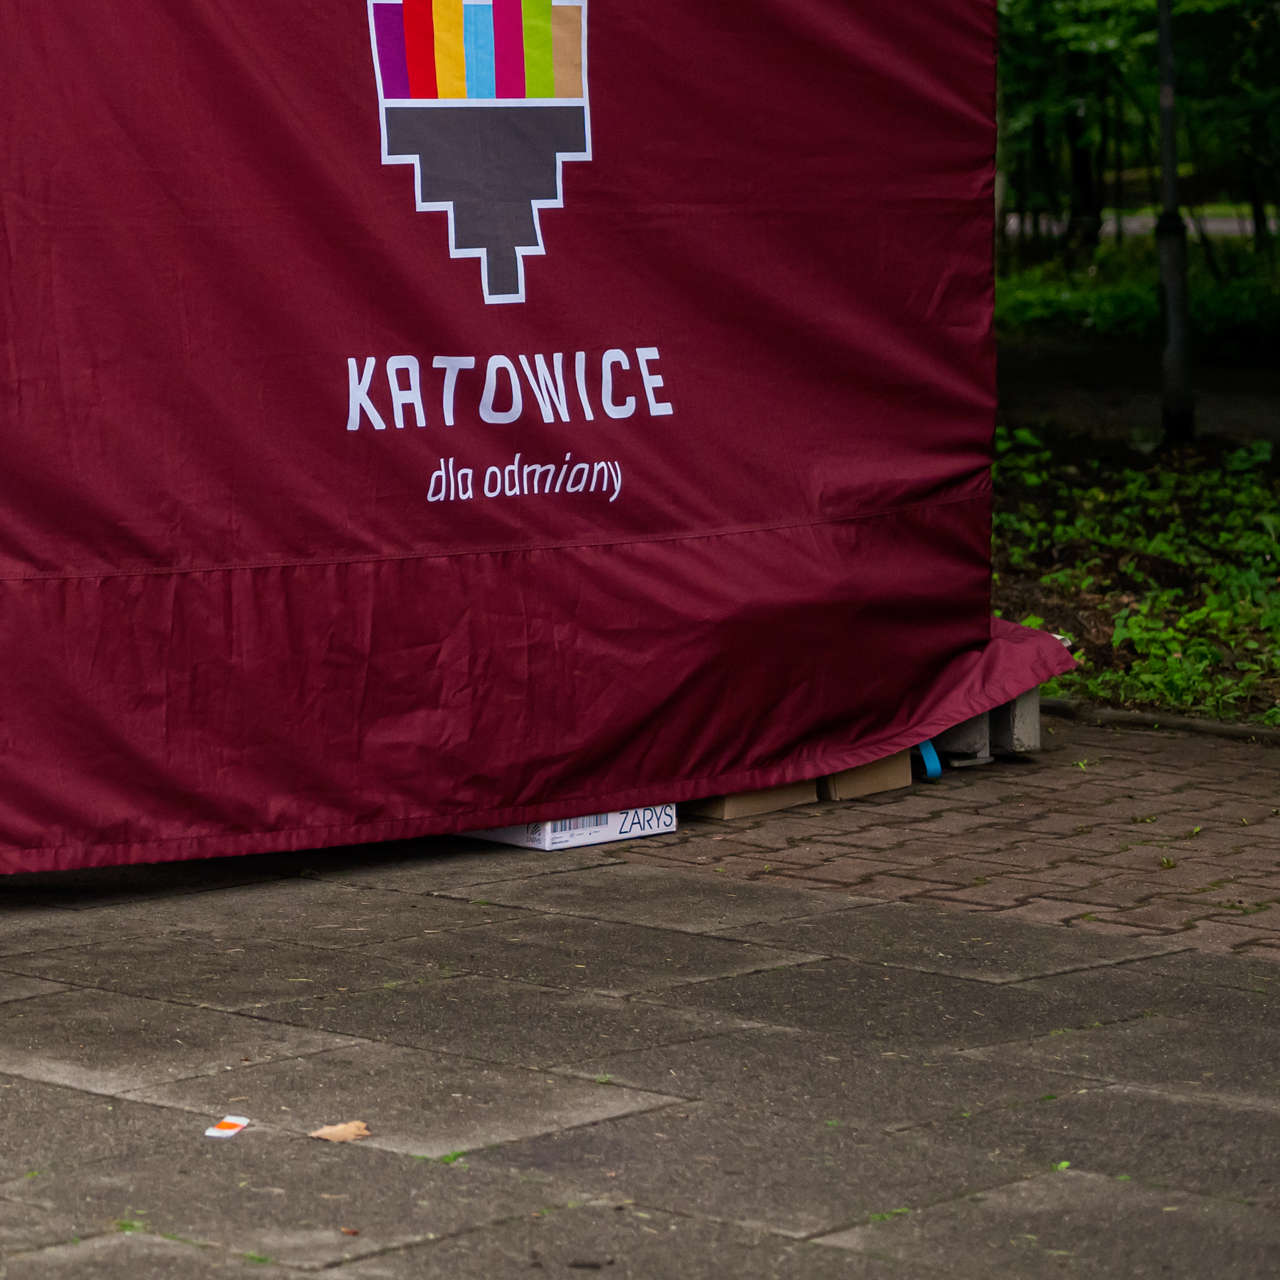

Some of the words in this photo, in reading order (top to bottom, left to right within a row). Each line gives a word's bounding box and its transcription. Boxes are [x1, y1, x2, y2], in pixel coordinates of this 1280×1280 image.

[346, 346, 674, 431] KATOWICE
[426, 456, 474, 503] dla
[484, 451, 622, 503] odmiany
[619, 804, 674, 835] ZARYS
